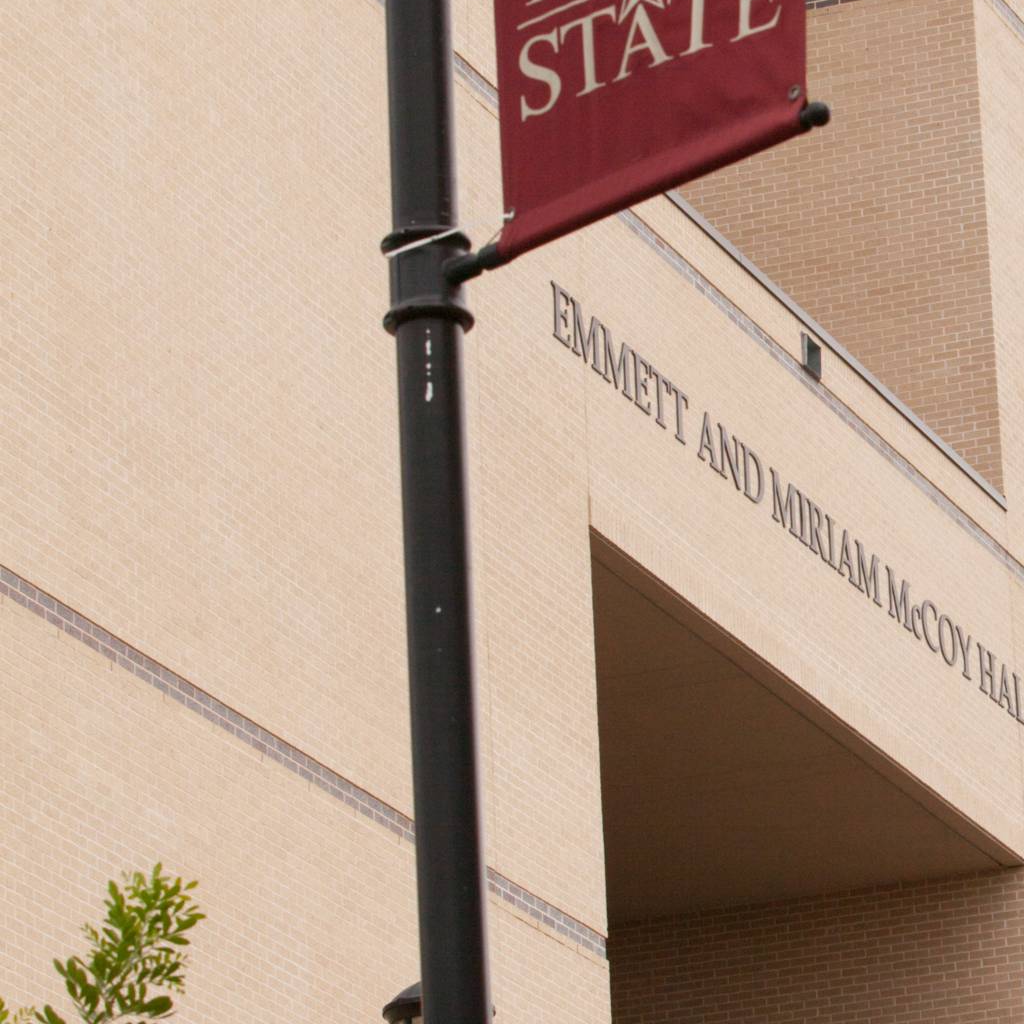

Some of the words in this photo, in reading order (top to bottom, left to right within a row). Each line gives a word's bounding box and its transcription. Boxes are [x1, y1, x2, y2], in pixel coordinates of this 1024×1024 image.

[550, 280, 689, 446] EMMETT
[697, 411, 765, 504] AND
[769, 466, 882, 608] MIRIAM
[885, 564, 972, 681] McCOY
